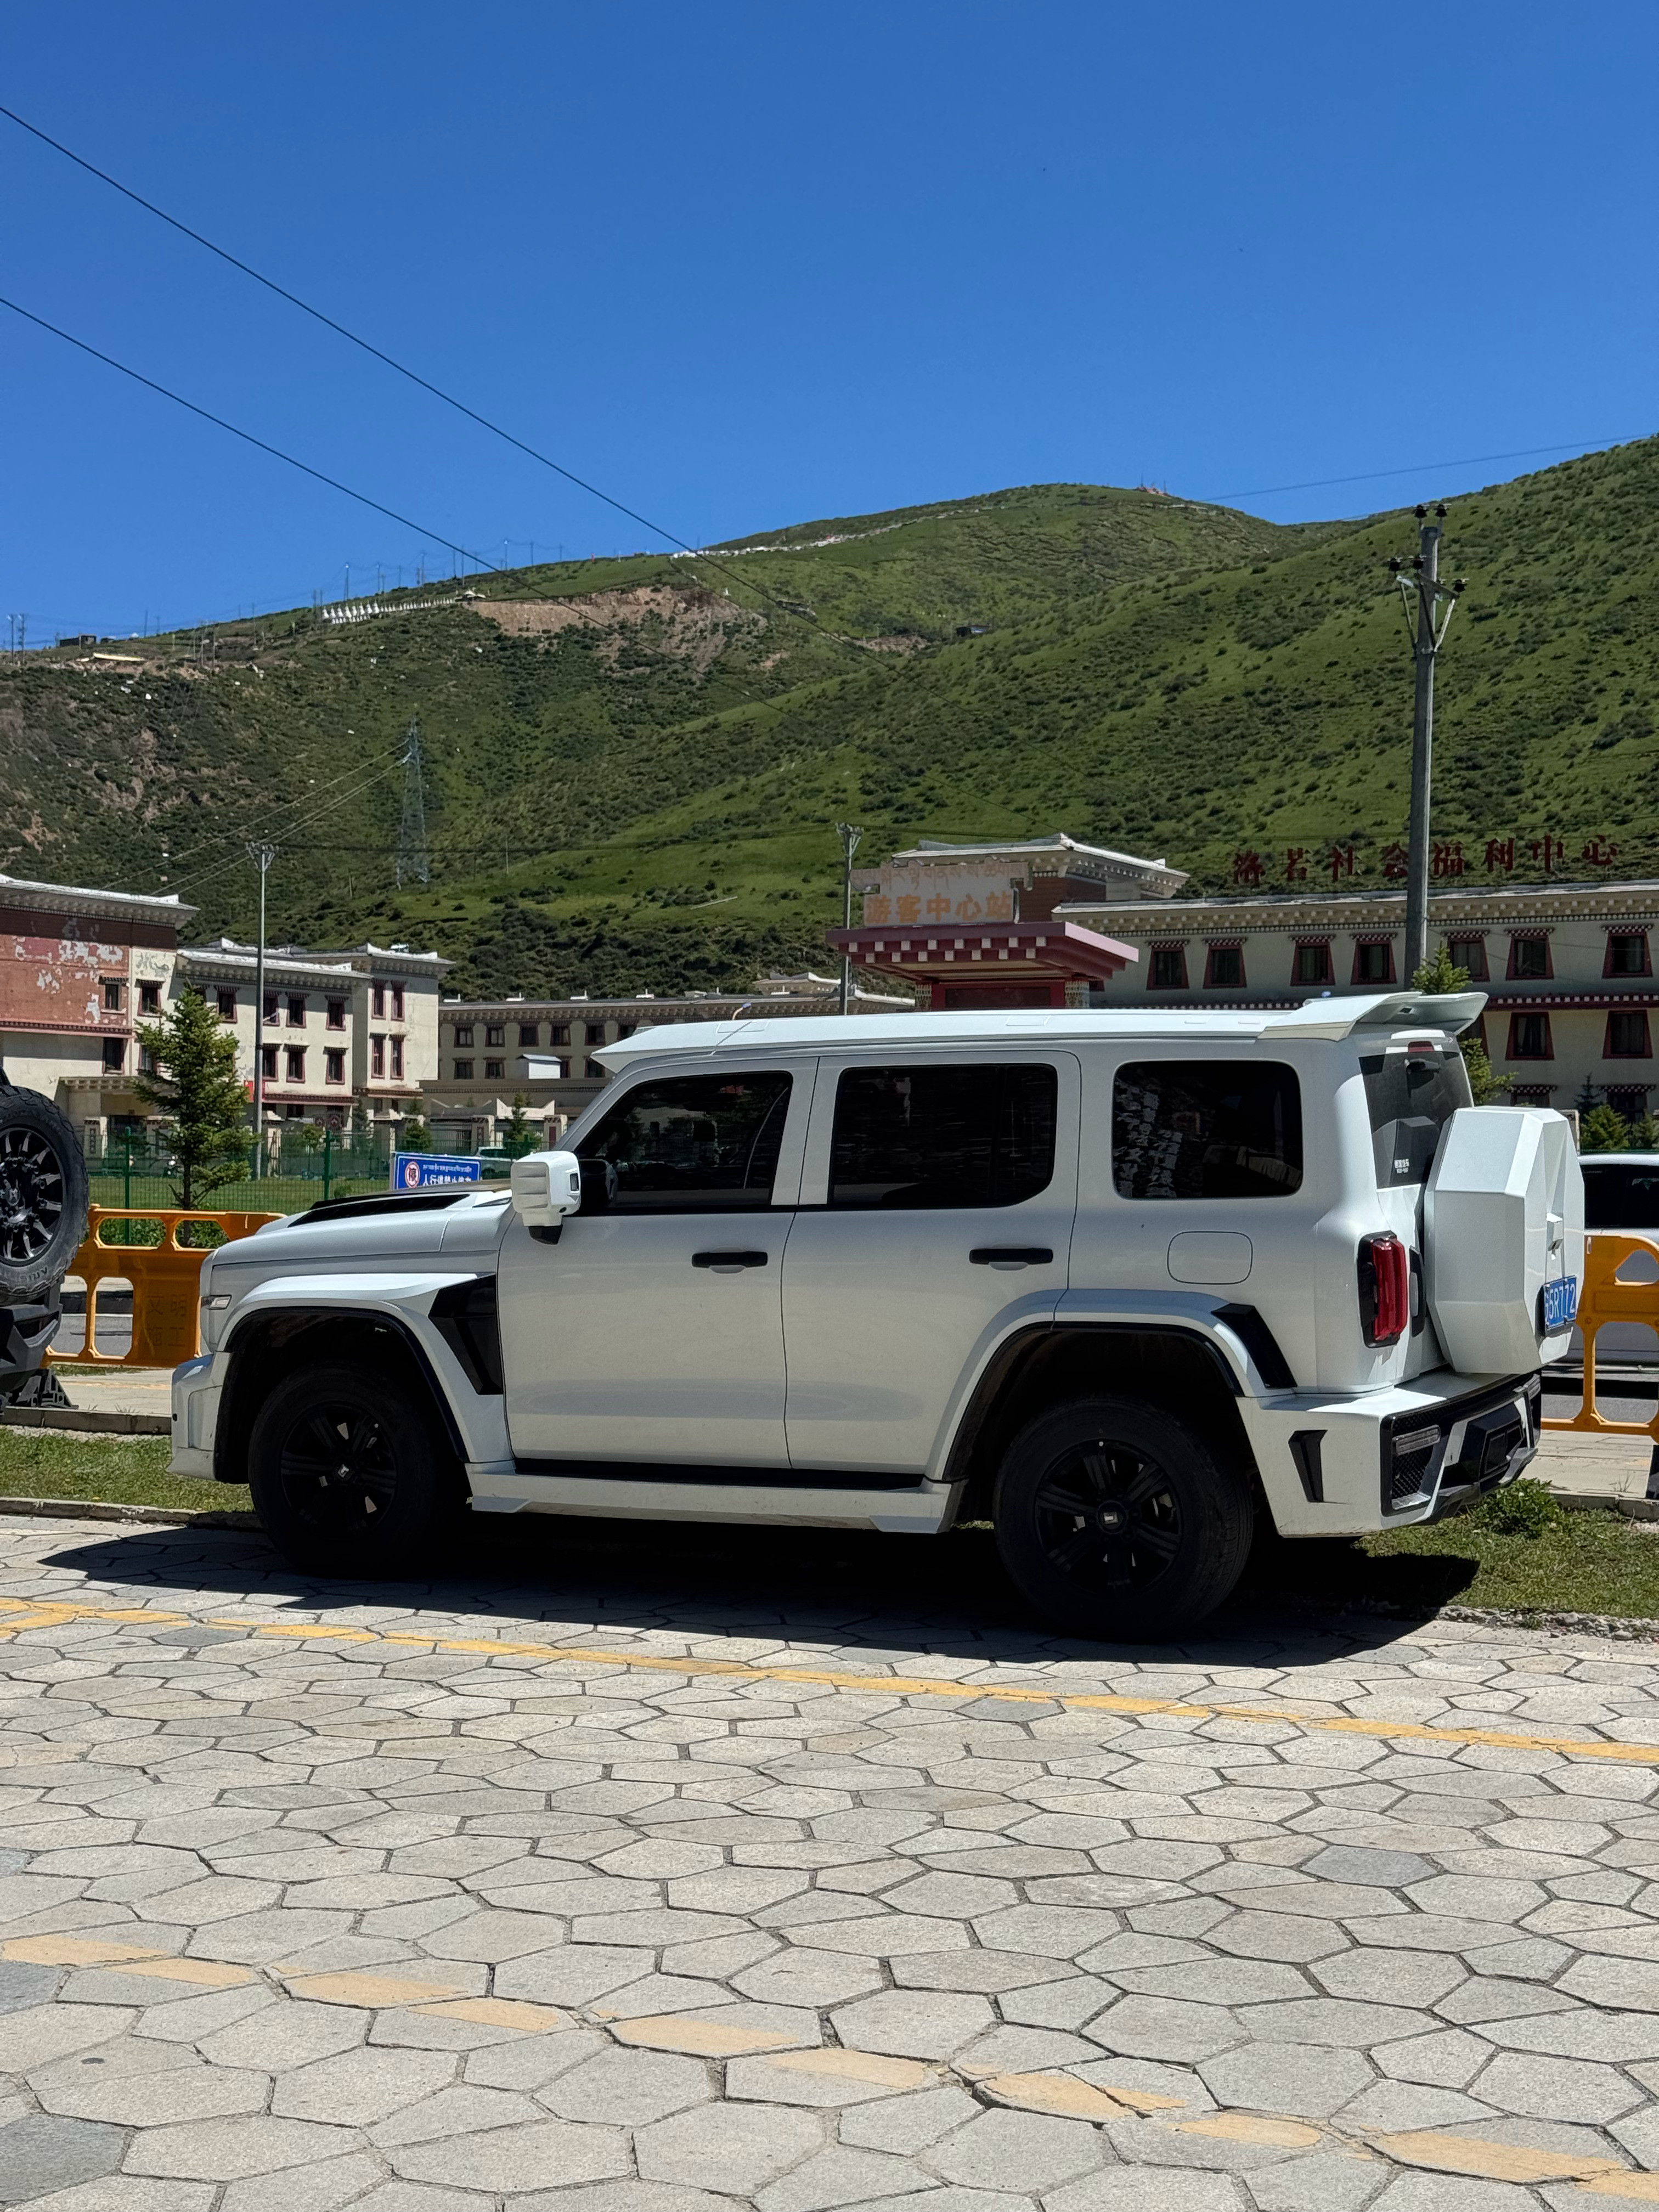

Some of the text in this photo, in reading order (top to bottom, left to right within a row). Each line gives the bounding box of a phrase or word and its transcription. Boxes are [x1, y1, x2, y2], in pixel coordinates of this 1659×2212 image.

[865, 890, 1013, 924] 游客中心站
